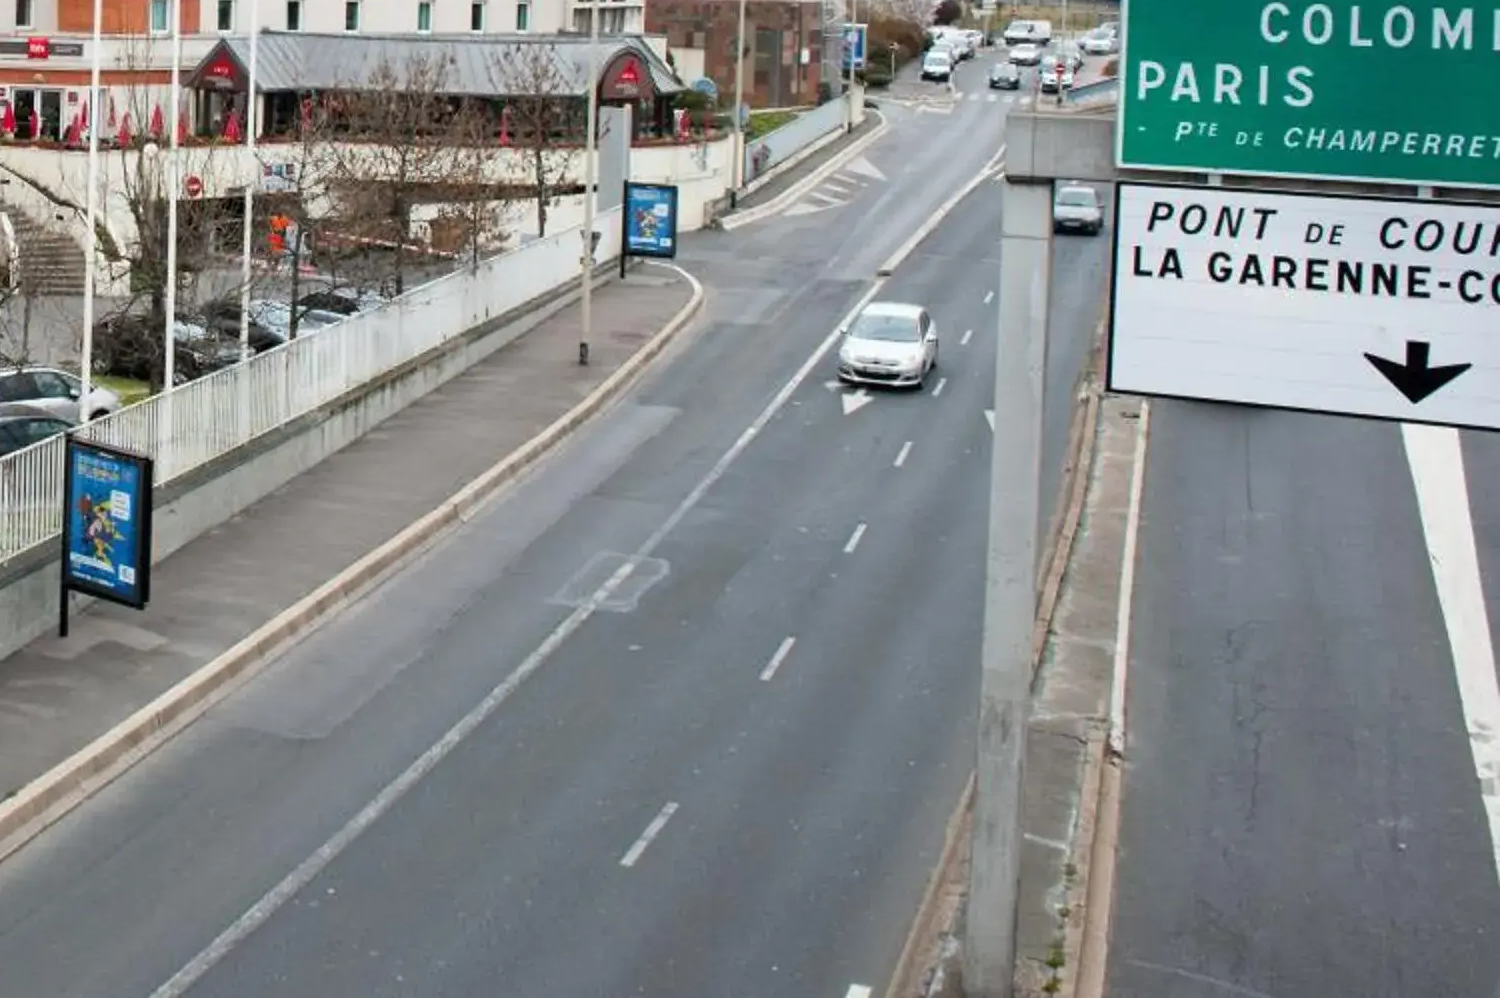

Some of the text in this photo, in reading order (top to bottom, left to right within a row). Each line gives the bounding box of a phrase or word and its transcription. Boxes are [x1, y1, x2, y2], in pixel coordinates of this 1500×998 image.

[1137, 61, 1314, 107] PARIS
[1235, 131, 1264, 147] DE
[1147, 202, 1277, 239] PONT
[1304, 223, 1345, 246] DE
[1132, 246, 1183, 279] LA
